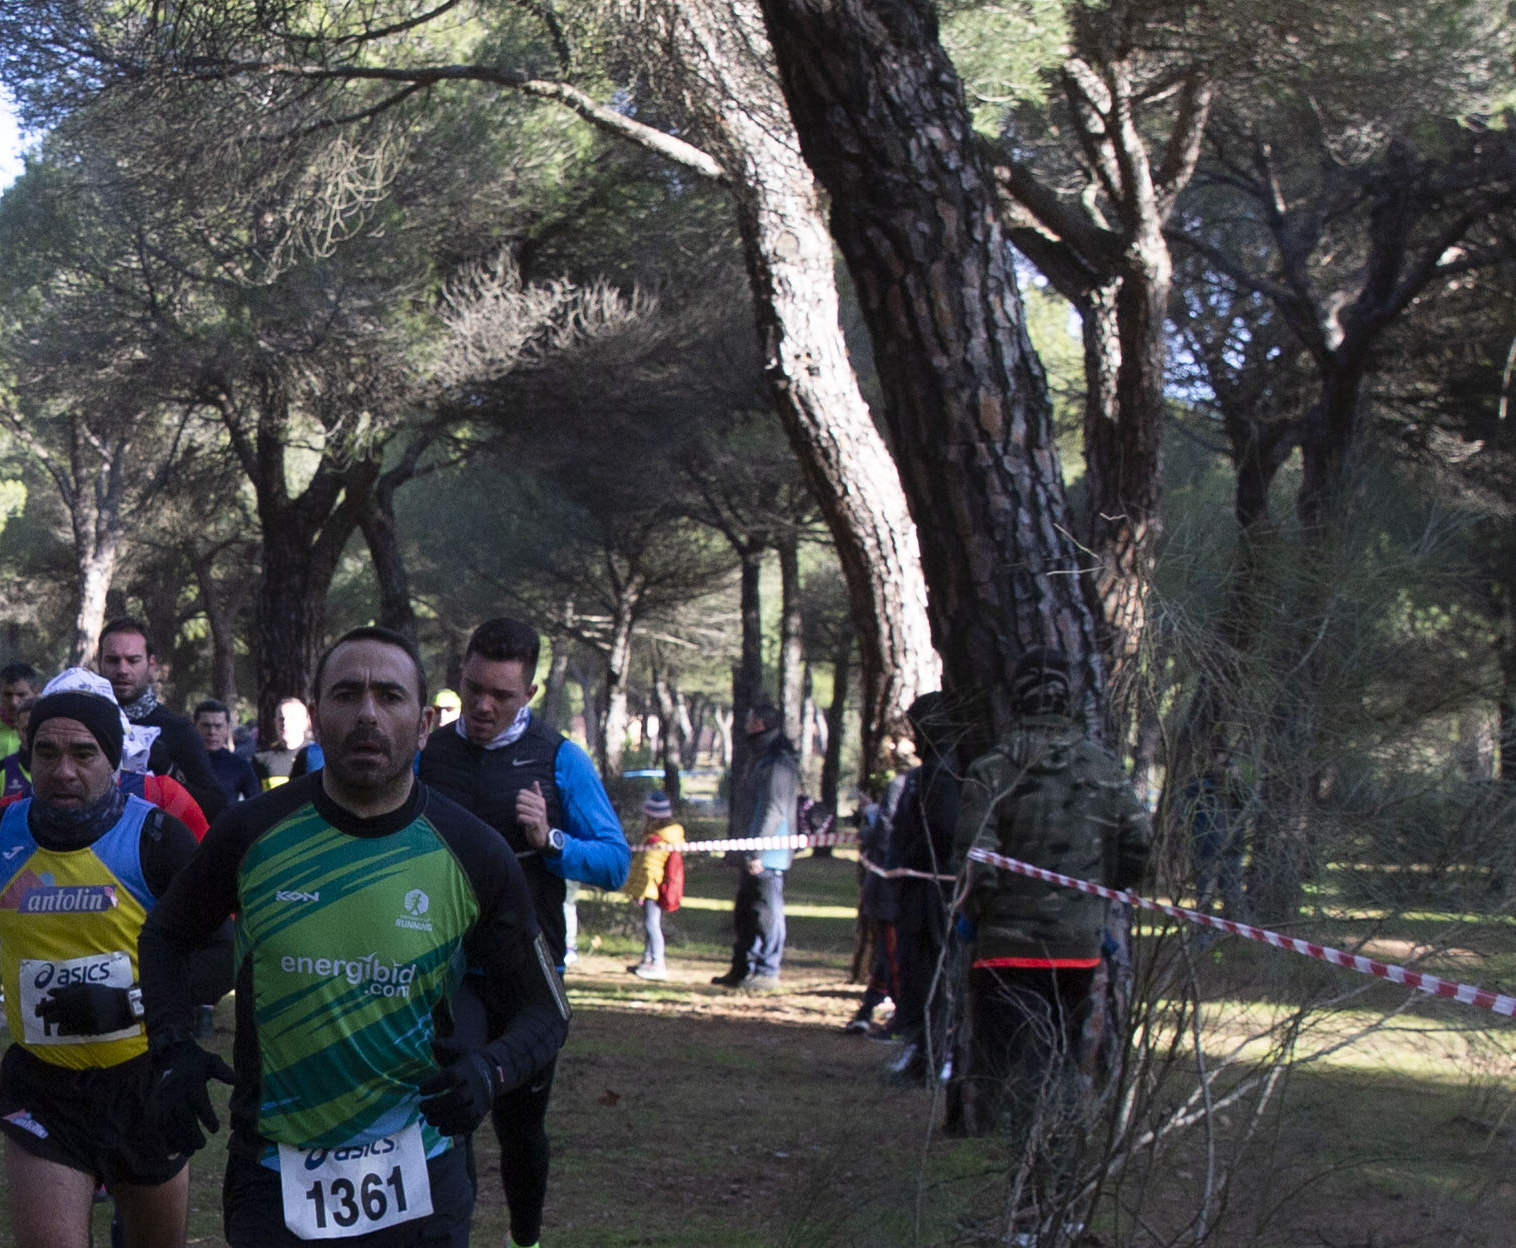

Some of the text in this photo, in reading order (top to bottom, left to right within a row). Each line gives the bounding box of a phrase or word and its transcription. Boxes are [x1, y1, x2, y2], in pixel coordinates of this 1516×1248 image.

[28, 888, 103, 911] antolin
[57, 962, 110, 985] asics
[364, 983, 410, 998] .com
[306, 1165, 407, 1229] 1361
